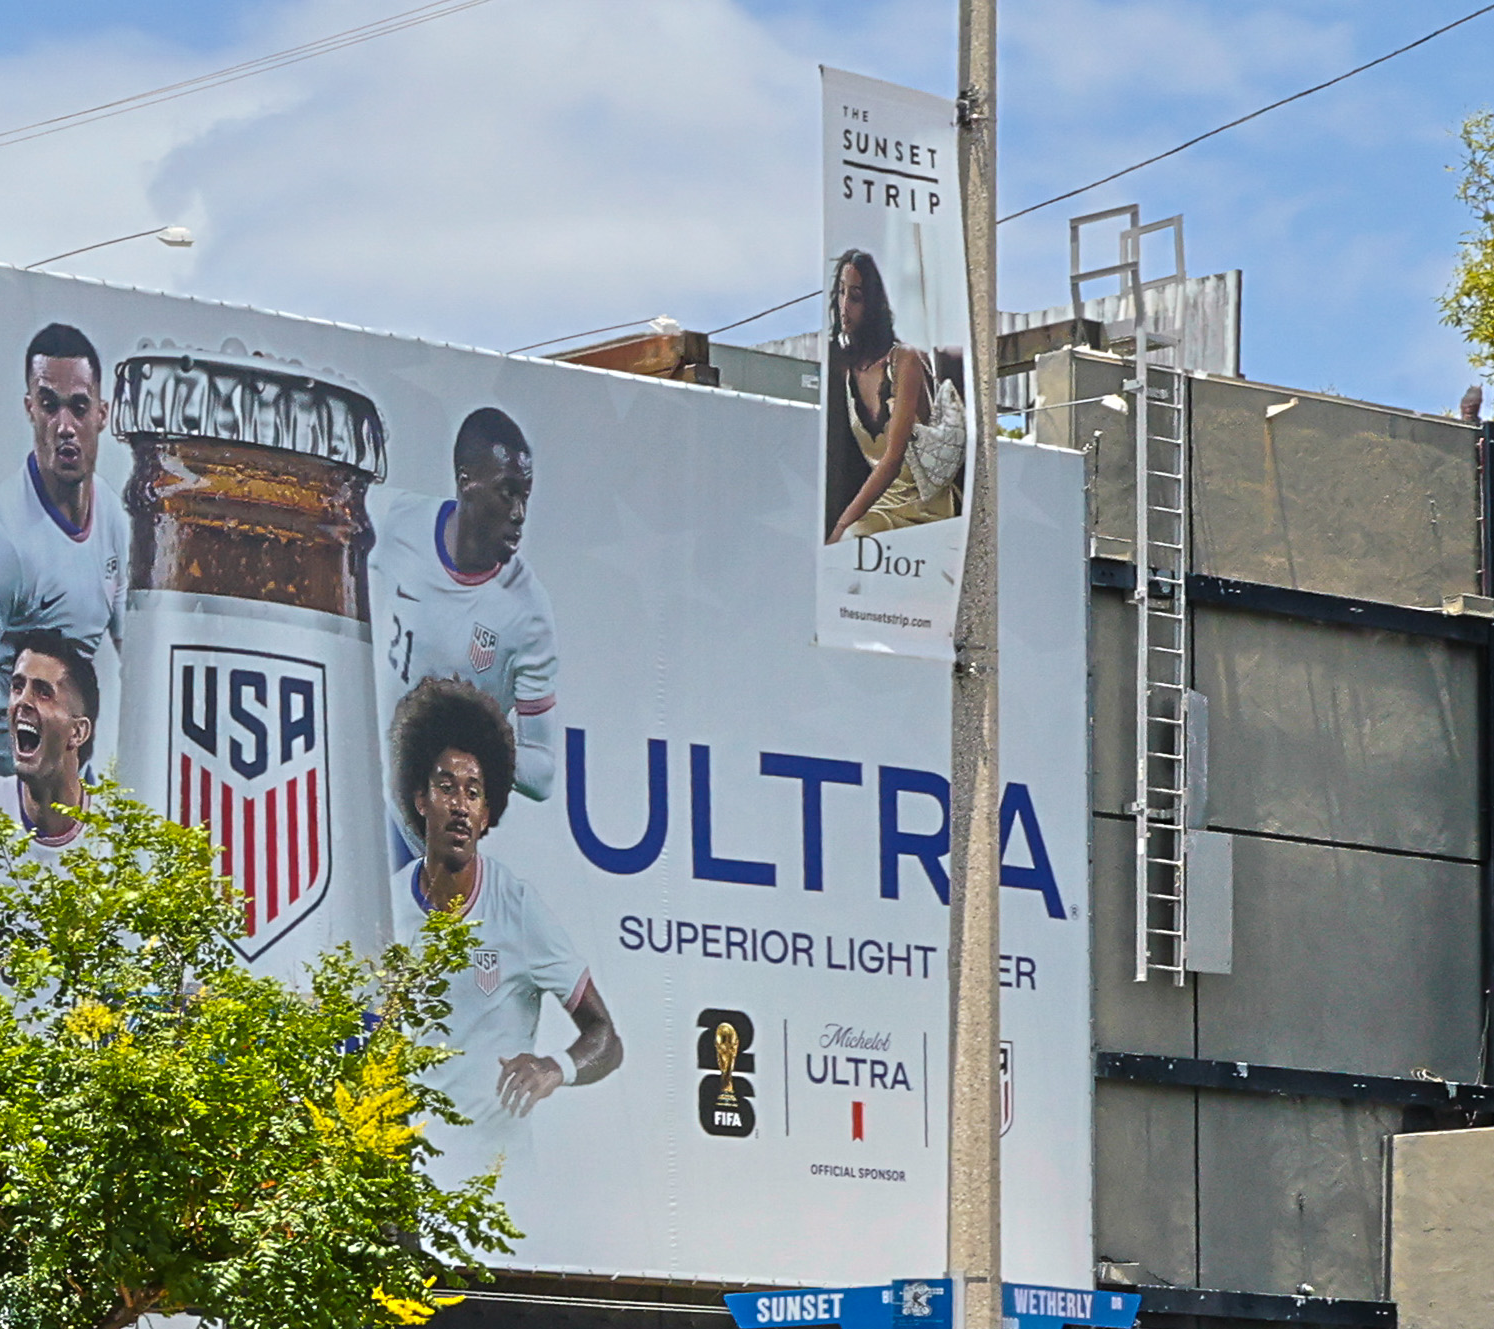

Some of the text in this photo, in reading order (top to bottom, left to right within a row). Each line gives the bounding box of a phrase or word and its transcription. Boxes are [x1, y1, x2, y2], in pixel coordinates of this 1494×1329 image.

[843, 105, 869, 123] THE
[843, 129, 937, 169] SUNSET
[843, 175, 940, 214] STRIP
[853, 534, 926, 577] Dior
[839, 606, 932, 628] thesunsetstrip.com
[473, 625, 497, 649] USA
[181, 665, 316, 780] USA
[565, 727, 1068, 920] ULTRA
[475, 953, 497, 970] USA
[619, 916, 1037, 991] SUPERIOR LIGHT ER
[820, 1023, 892, 1052] Michelob
[806, 1053, 913, 1092] ULTRA
[714, 1111, 742, 1128] FIFA
[810, 1163, 906, 1182] OFFICIAL SPONSOR
[757, 1293, 844, 1323] SUNSET
[1014, 1288, 1093, 1319] WETHERLY
